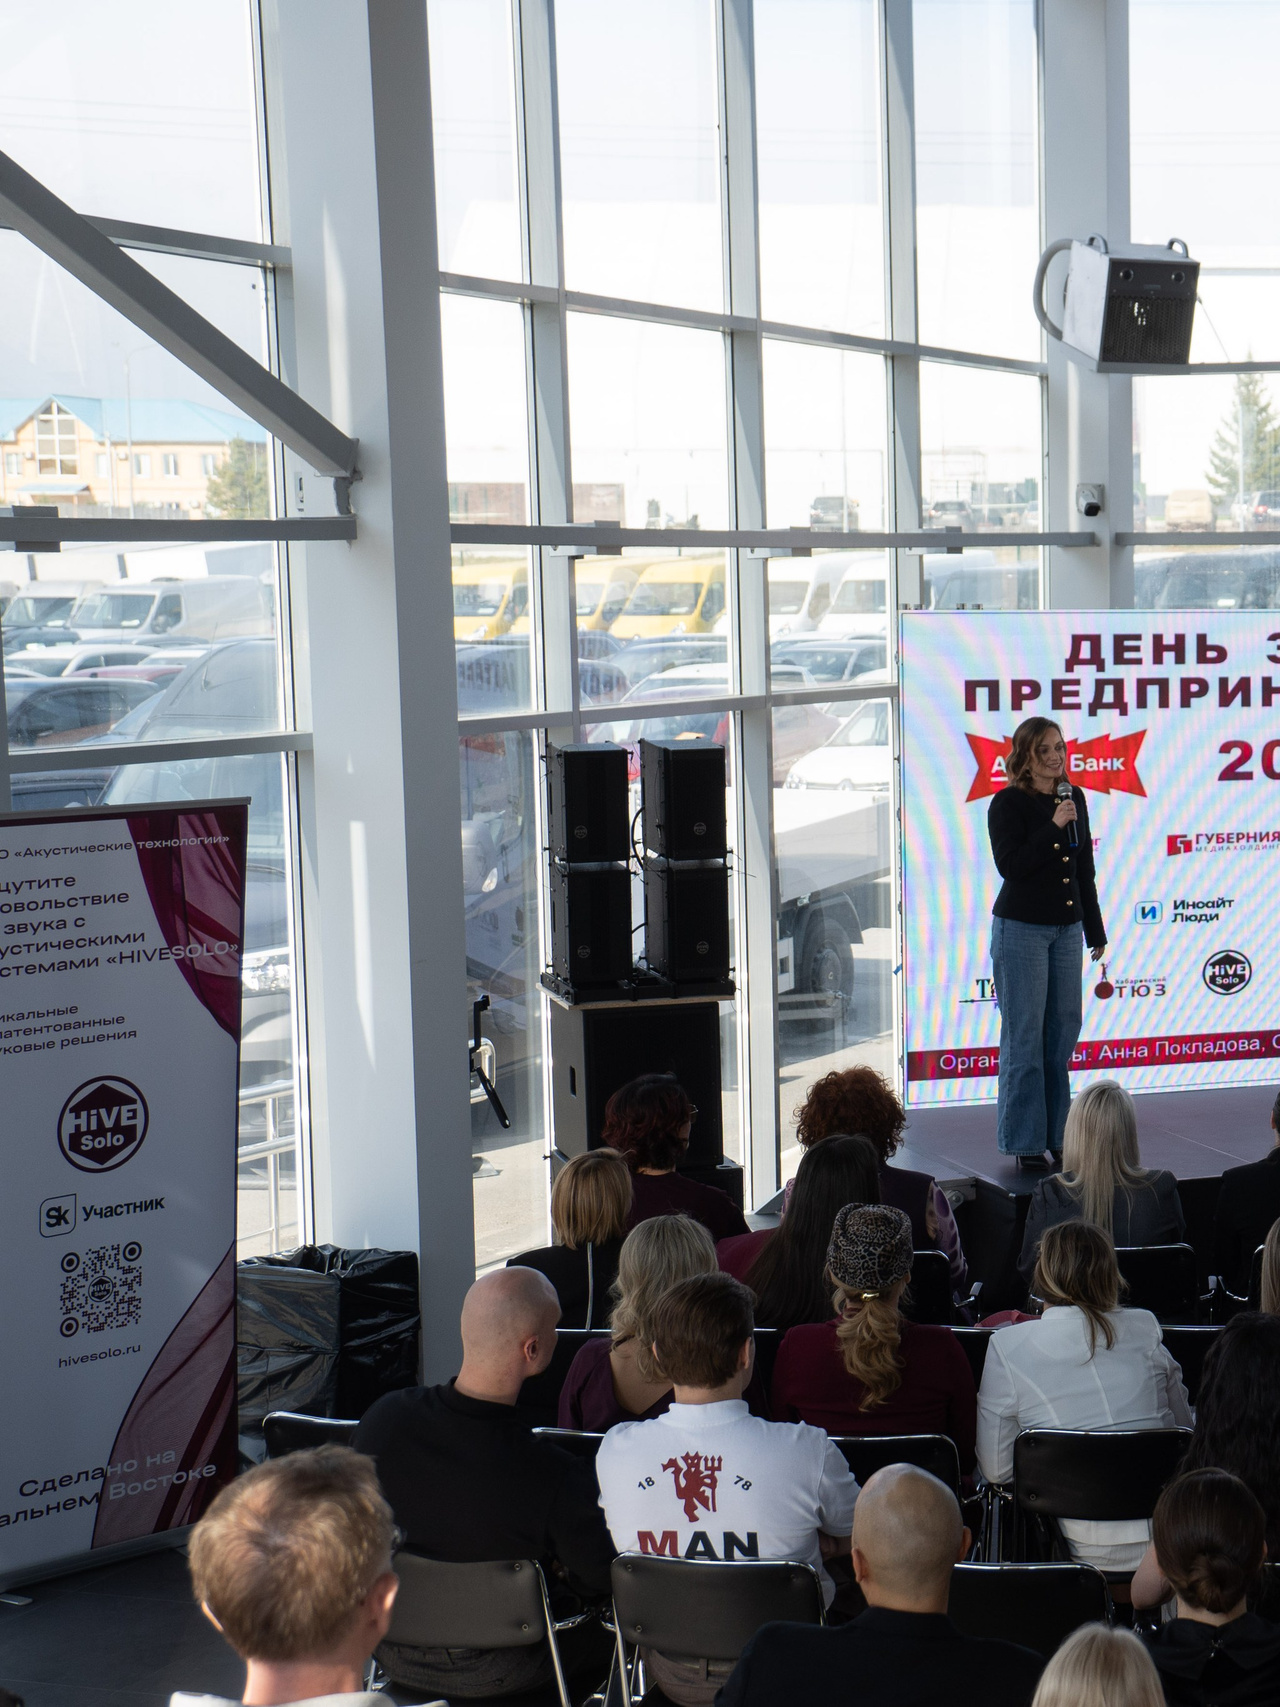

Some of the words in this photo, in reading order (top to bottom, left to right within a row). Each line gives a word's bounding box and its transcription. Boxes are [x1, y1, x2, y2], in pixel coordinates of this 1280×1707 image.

[1065, 633, 1228, 672] ДЕНЬ
[1069, 753, 1126, 772] Банк
[14, 841, 133, 859] «Акустические
[137, 835, 230, 849] технологии»
[1195, 831, 1280, 844] ГУБЕРНИЯ
[4, 918, 67, 935] звука
[74, 917, 86, 927] с
[1171, 913, 1219, 924] Люди
[1115, 984, 1166, 998] ТЮЗ
[1215, 976, 1239, 984] Solo
[0, 1016, 125, 1039] атентованные
[0, 1041, 55, 1055] ковые
[60, 1030, 137, 1050] решения
[1099, 1044, 1149, 1060] Анна
[1155, 1038, 1265, 1057] Покладова,
[81, 1132, 125, 1150] Solo
[45, 1205, 70, 1228] Sk
[82, 1197, 165, 1222] Участник
[58, 1345, 141, 1368] hivesolo.ru
[19, 1459, 138, 1497] Сделано
[146, 1450, 176, 1467] на
[109, 1464, 217, 1500] Востоке
[638, 1476, 655, 1491] 18
[733, 1475, 752, 1491] 78
[637, 1530, 759, 1560] MAN
